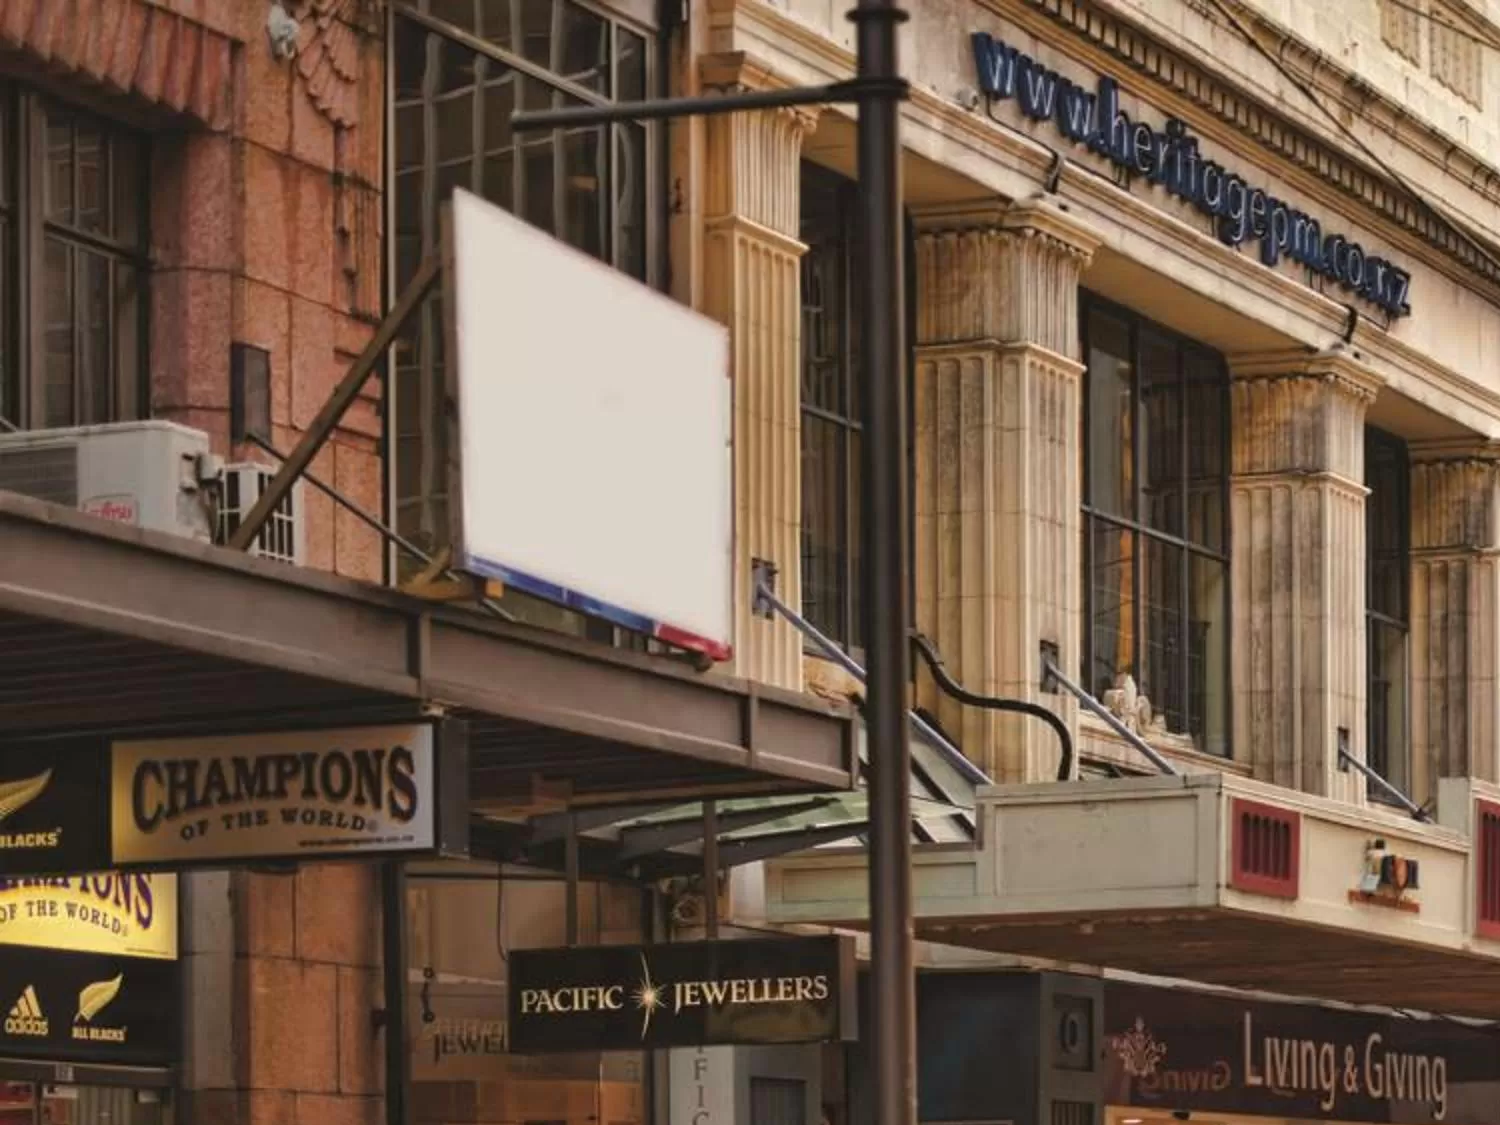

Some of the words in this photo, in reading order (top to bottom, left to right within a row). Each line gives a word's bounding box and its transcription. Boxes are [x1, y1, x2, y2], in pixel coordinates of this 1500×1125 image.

[132, 746, 417, 834] CHAMPIONS
[180, 819, 209, 841] OF
[221, 809, 269, 829] THE
[26, 899, 58, 918] THE
[65, 902, 121, 936] WORLD
[519, 985, 625, 1014] PACIFIC
[673, 974, 829, 1015] JEWELLERS
[1243, 1010, 1337, 1111] Living
[1344, 1044, 1358, 1093] &
[1364, 1032, 1448, 1121] Giving
